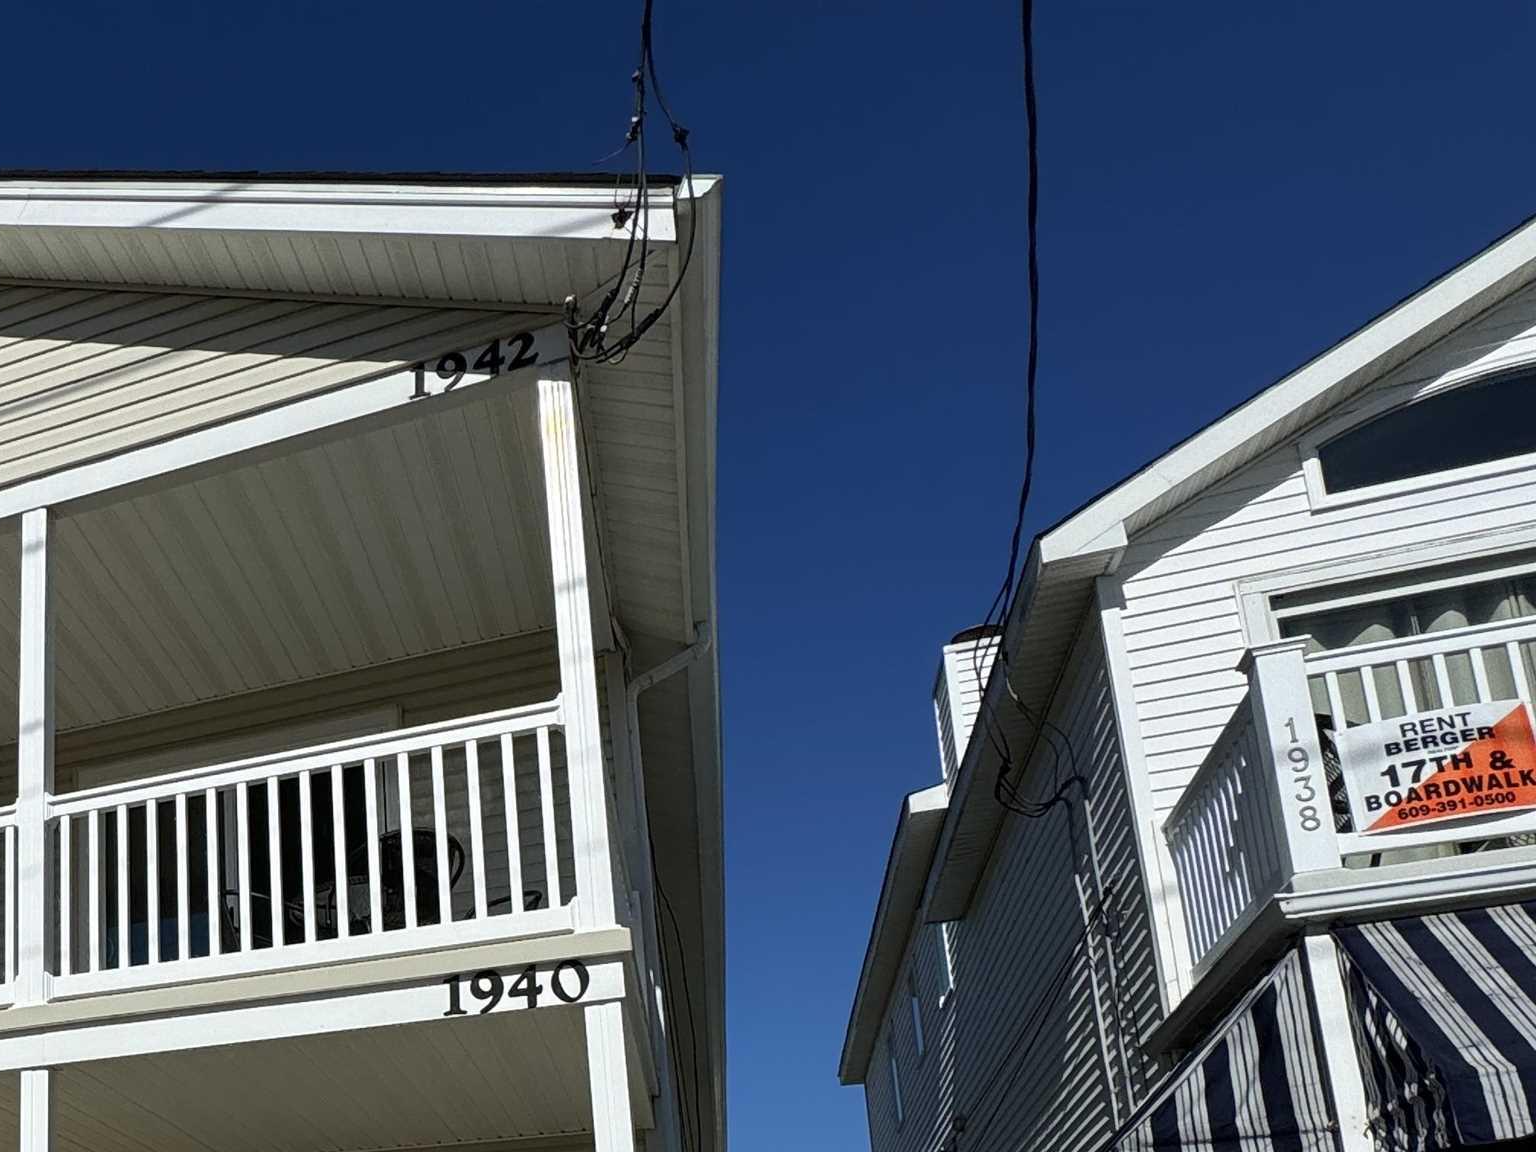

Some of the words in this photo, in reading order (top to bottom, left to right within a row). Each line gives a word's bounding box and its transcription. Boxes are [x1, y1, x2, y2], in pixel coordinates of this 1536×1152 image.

[408, 332, 539, 400] 1942
[1384, 726, 1496, 757] BERGER
[1399, 712, 1472, 738] RENT
[1284, 716, 1321, 832] 1938
[1380, 752, 1474, 788] 17TH
[1489, 750, 1516, 771] &
[1364, 769, 1536, 812] BOARDWALK
[1397, 791, 1516, 820] 609-391-0500
[443, 959, 590, 1017] 1940
